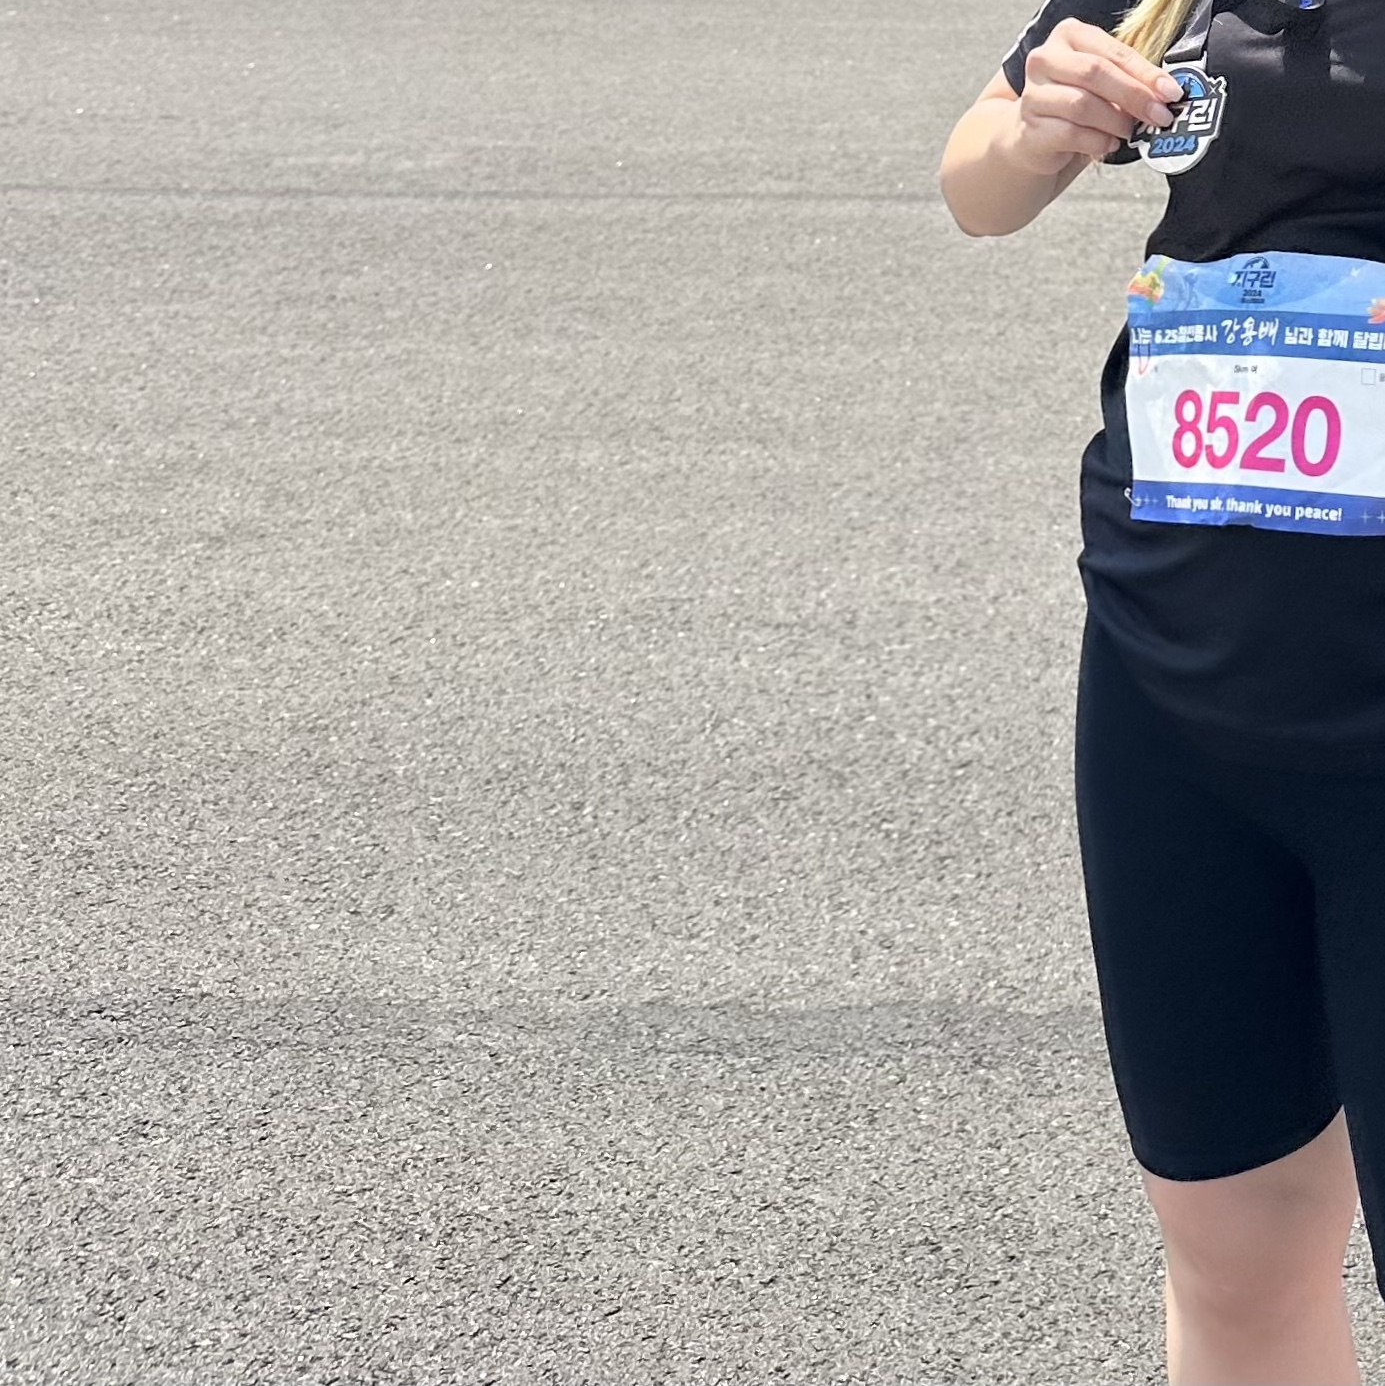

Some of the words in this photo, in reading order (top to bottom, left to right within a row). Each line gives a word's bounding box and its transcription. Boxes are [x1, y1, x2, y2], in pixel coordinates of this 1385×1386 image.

[1151, 135, 1196, 155] 2024
[1221, 316, 1279, 346] 강용배
[1284, 326, 1314, 346] 님과
[1317, 328, 1349, 349] 함께
[1172, 388, 1342, 477] 8520
[1226, 499, 1263, 515] thank
[1265, 503, 1292, 518] you
[1294, 505, 1342, 522] peace!
